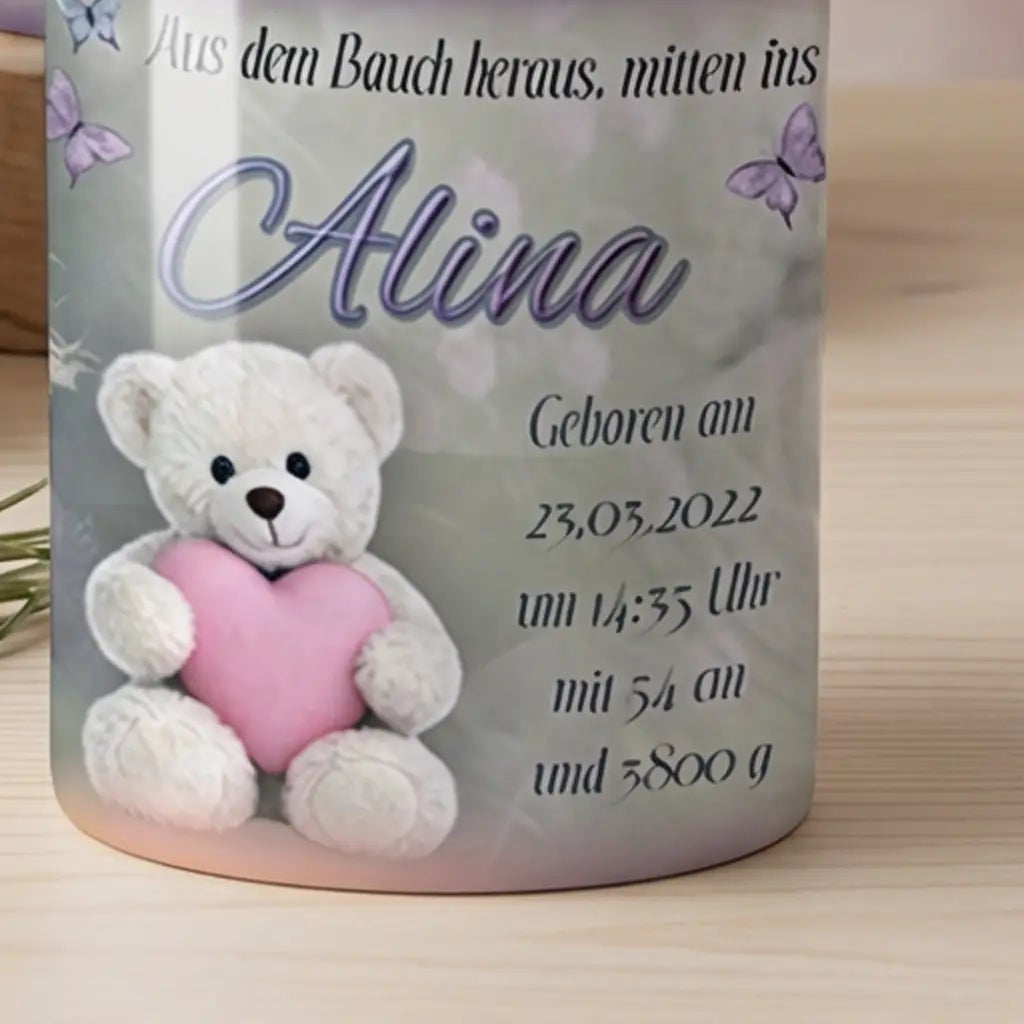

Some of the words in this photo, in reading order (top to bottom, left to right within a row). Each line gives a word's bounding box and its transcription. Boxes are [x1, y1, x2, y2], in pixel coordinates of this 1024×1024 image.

[144, 13, 228, 76] Aus
[241, 26, 320, 86] dem
[330, 32, 453, 96] Bauch
[621, 45, 746, 98] mitten
[761, 39, 820, 89] ins
[158, 137, 691, 330] Alina
[529, 394, 685, 449] Geboren
[697, 396, 756, 438] am
[518, 592, 577, 628] um
[533, 747, 608, 796] und
[749, 743, 773, 790] g
